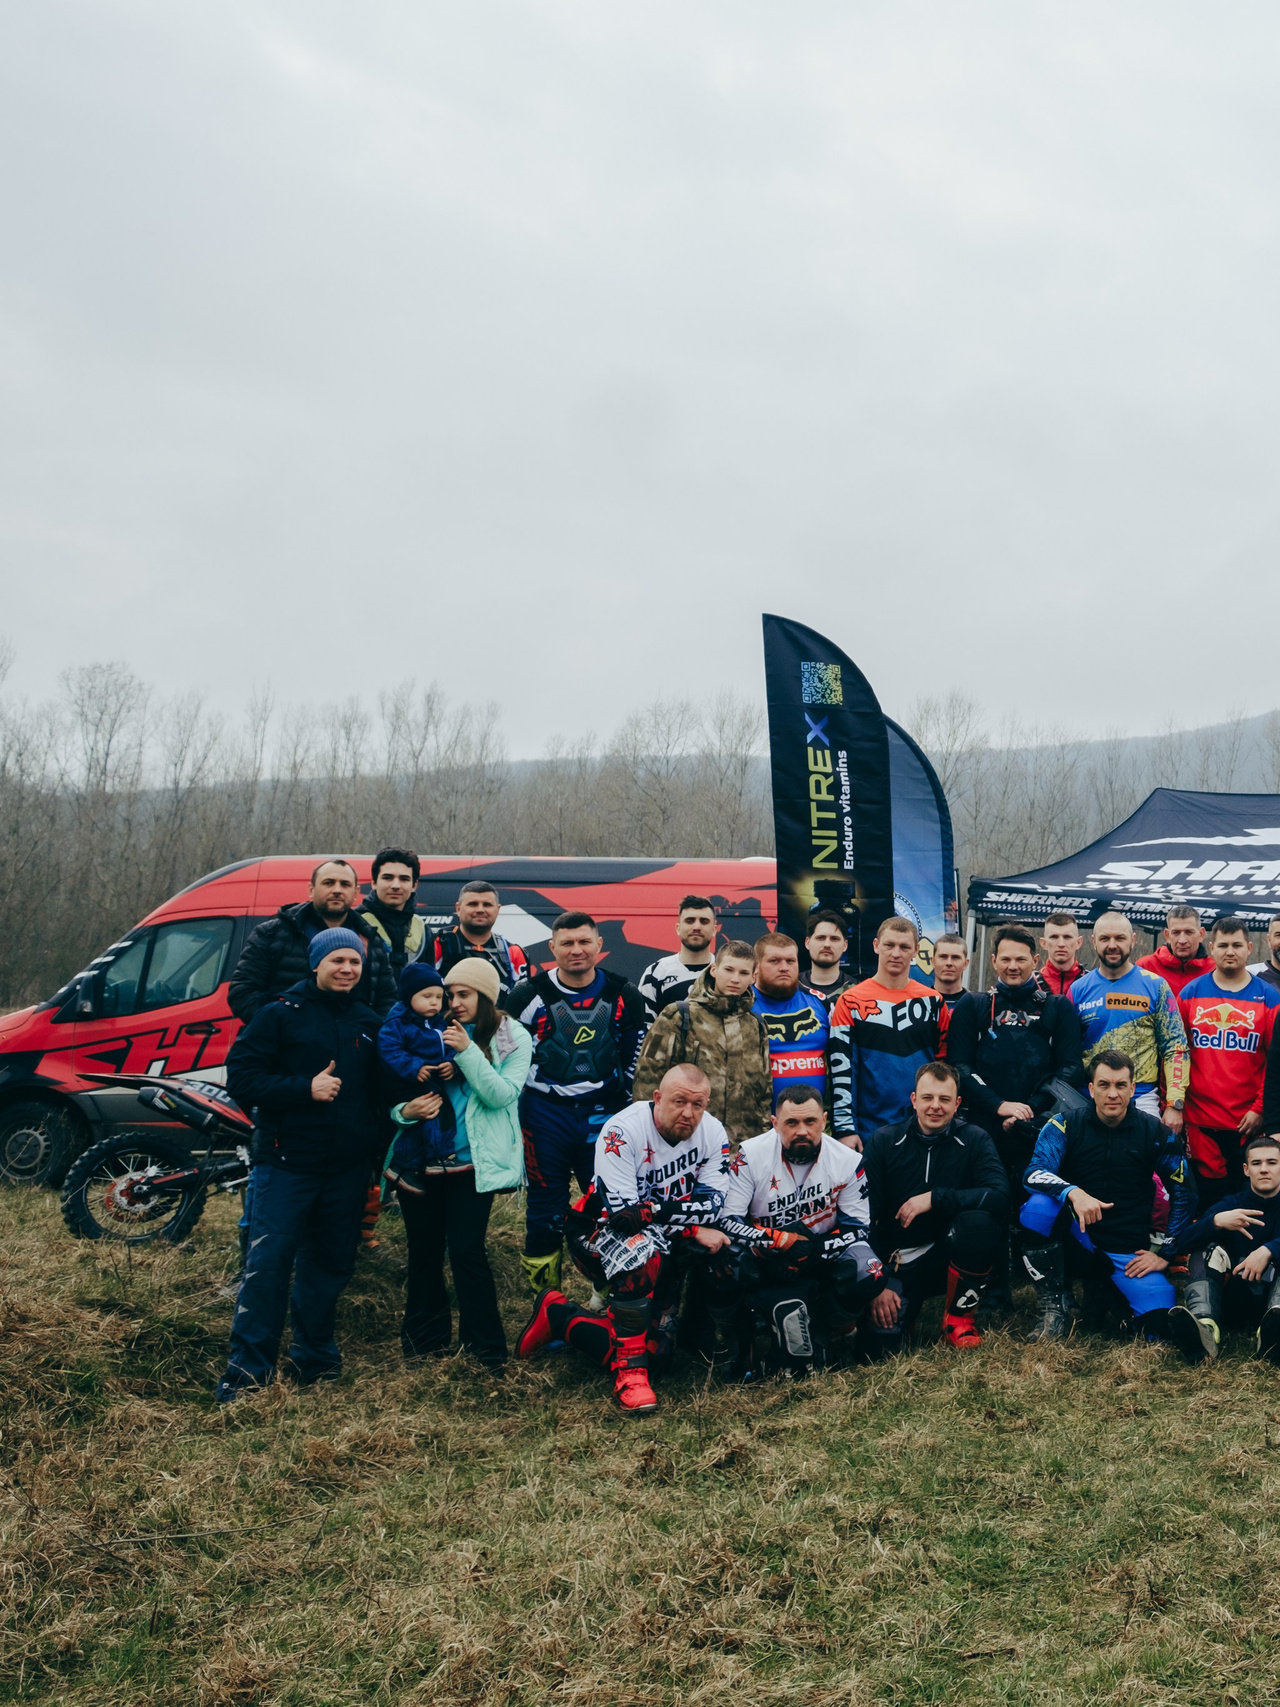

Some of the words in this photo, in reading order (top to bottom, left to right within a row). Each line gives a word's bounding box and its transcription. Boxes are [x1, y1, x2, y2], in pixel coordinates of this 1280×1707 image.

[804, 711, 839, 869] NITREX
[836, 749, 852, 813] vitamins
[838, 816, 854, 870] Enduro
[983, 891, 1098, 908] SHARMAX
[1051, 908, 1091, 916] RACE
[891, 996, 943, 1032] FOX
[1078, 997, 1104, 1012] Hard
[1106, 997, 1149, 1009] enduro
[1191, 1028, 1222, 1049] Red
[1224, 1030, 1260, 1053] Bull
[637, 1146, 699, 1191] ENDURO
[682, 1200, 713, 1212] ГАЗ
[824, 1231, 857, 1251] ГАЗ
